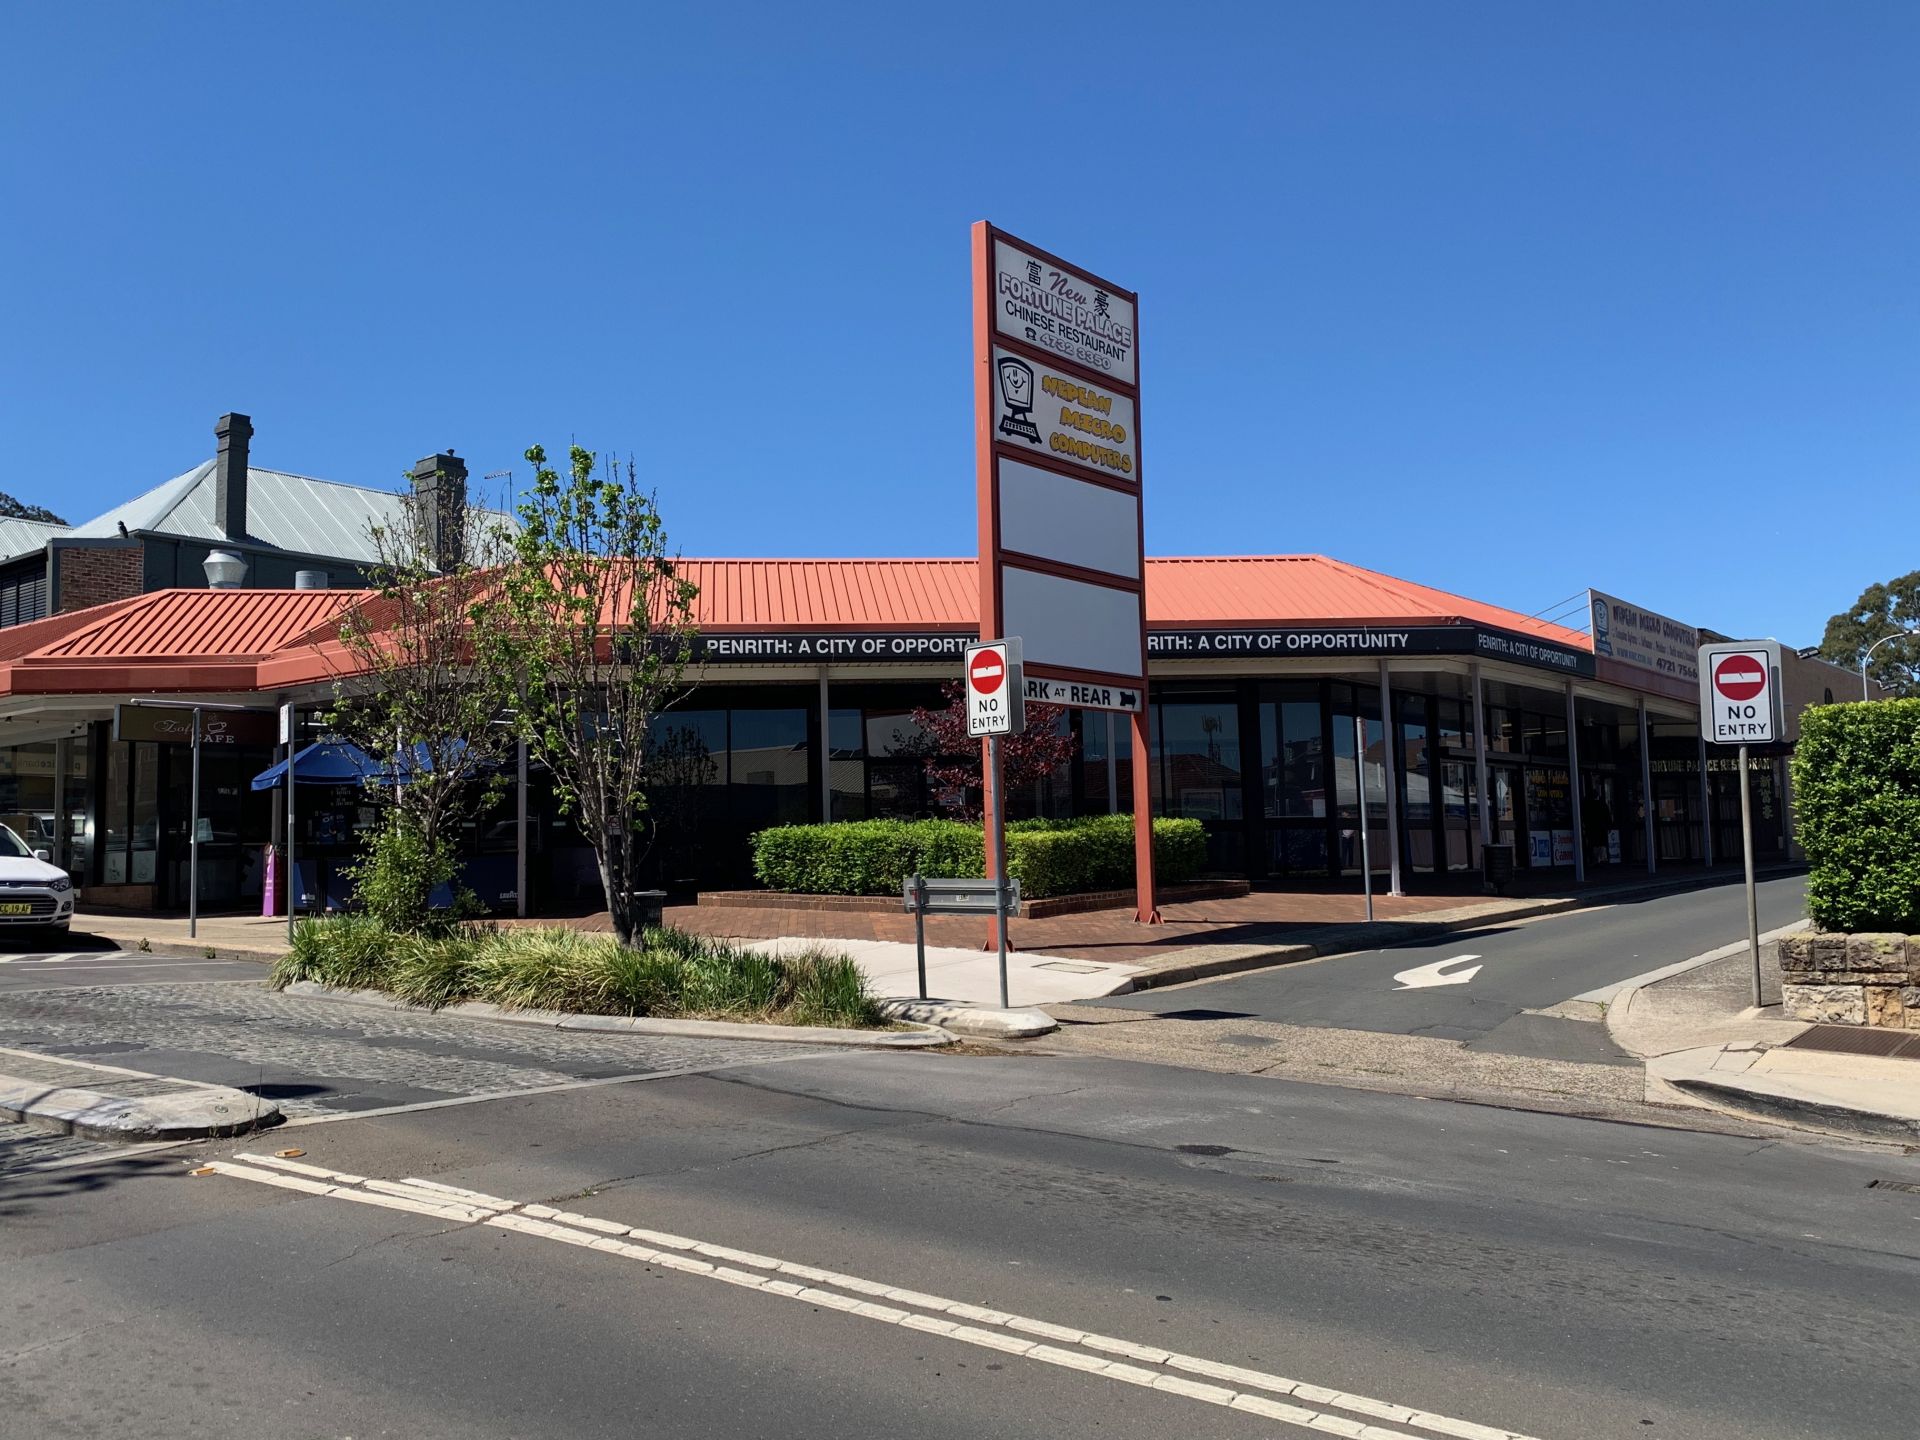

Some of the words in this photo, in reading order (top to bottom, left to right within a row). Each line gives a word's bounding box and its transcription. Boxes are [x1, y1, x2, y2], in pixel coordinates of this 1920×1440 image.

[1026, 260, 1042, 286] 富
[1049, 271, 1087, 305] New
[999, 271, 1073, 324] FORTUNE
[1075, 306, 1131, 348] PALACE
[1093, 289, 1110, 319] 豪
[1005, 300, 1055, 333] CHINESE
[1058, 323, 1126, 362] RESTAURANT
[1040, 333, 1075, 356] 4732
[1076, 346, 1111, 370] 3350
[1059, 406, 1126, 444] MICRO
[1049, 431, 1132, 473] COMPUTERS
[707, 639, 793, 654] PENRITH:
[799, 639, 811, 654] A
[816, 639, 856, 654] CITY
[861, 639, 887, 654] OF
[891, 638, 978, 653] OPPORT
[1147, 635, 1193, 650] RITH:
[1198, 635, 1210, 650] A
[1214, 634, 1254, 650] CITY
[1258, 634, 1282, 649] OF
[1286, 633, 1409, 649] OPPORTUNITY
[1478, 633, 1509, 653] PENRITH:
[1510, 641, 1515, 655] A
[1515, 642, 1529, 657] CITY
[1529, 646, 1538, 659] OF
[1539, 647, 1577, 668] OPPORTUNITY
[1656, 658, 1676, 673] 4721
[979, 698, 998, 713] NO
[1054, 687, 1067, 697] AT
[1071, 685, 1111, 706] REAR
[972, 715, 1006, 729] ENTRY
[1728, 705, 1756, 719] NO
[199, 734, 235, 744] AFE
[1718, 723, 1767, 735] ENTRY
